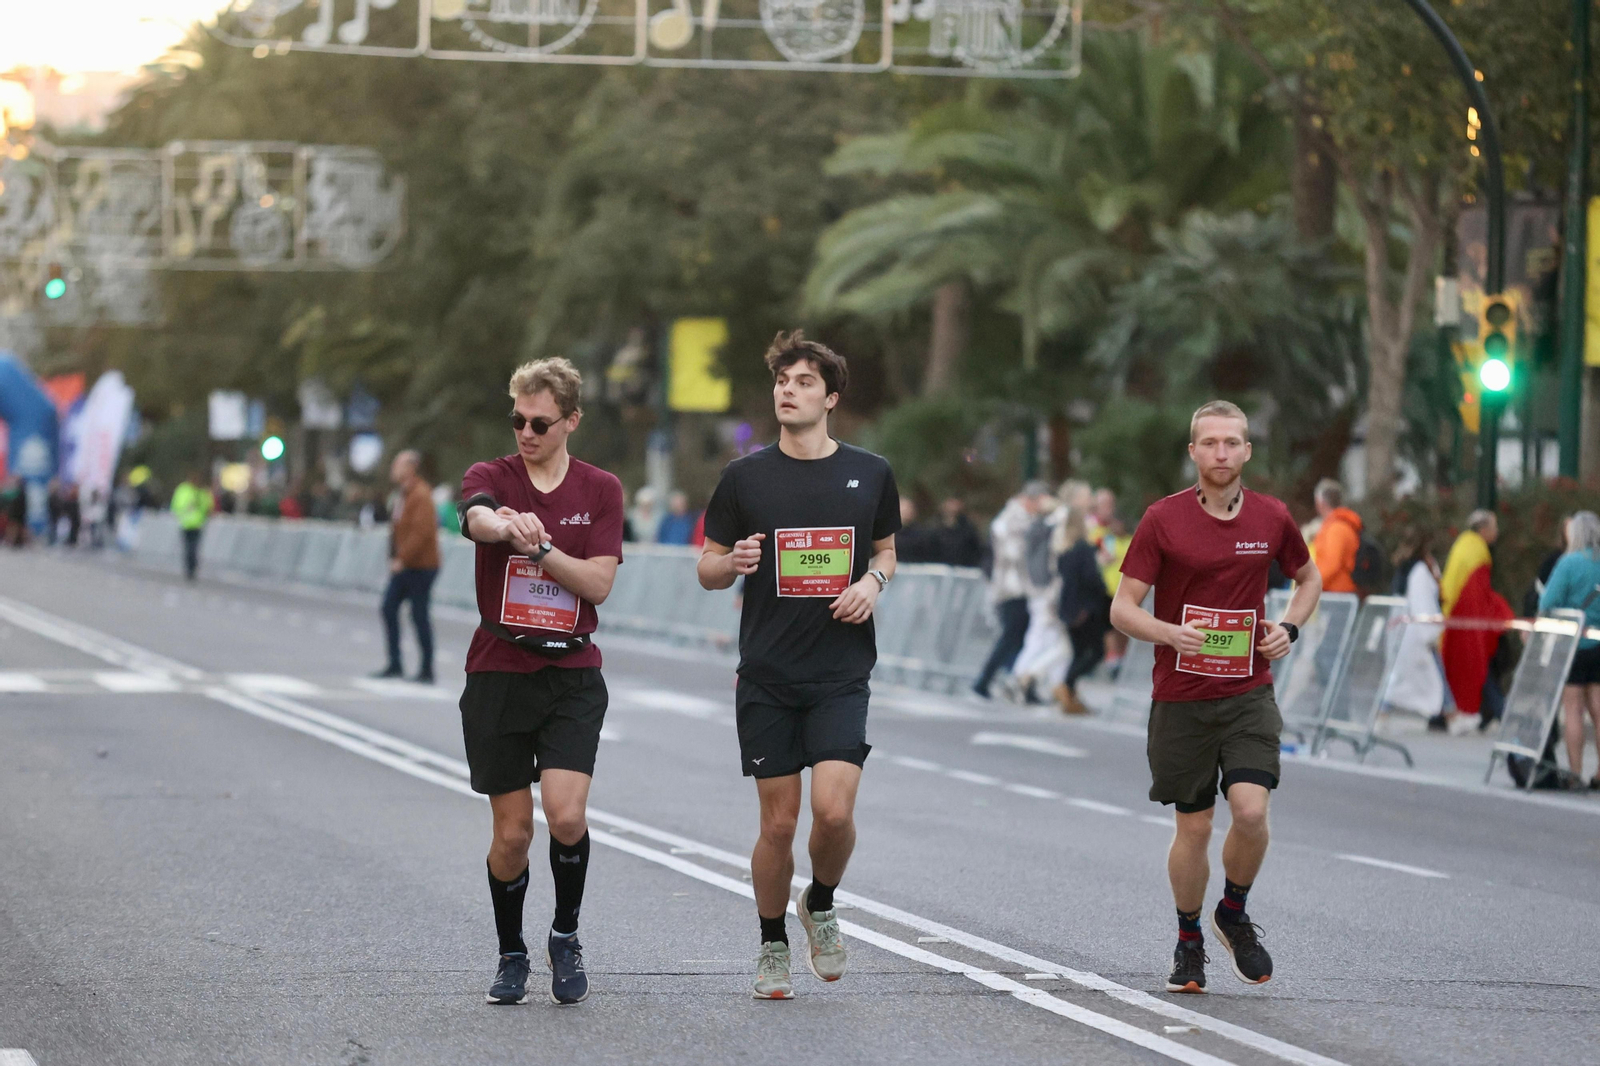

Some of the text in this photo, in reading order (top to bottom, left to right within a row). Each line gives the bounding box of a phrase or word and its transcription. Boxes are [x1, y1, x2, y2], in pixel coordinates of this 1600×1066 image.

[800, 553, 831, 565] 2996
[528, 583, 559, 597] 3610
[1204, 633, 1234, 646] 2997
